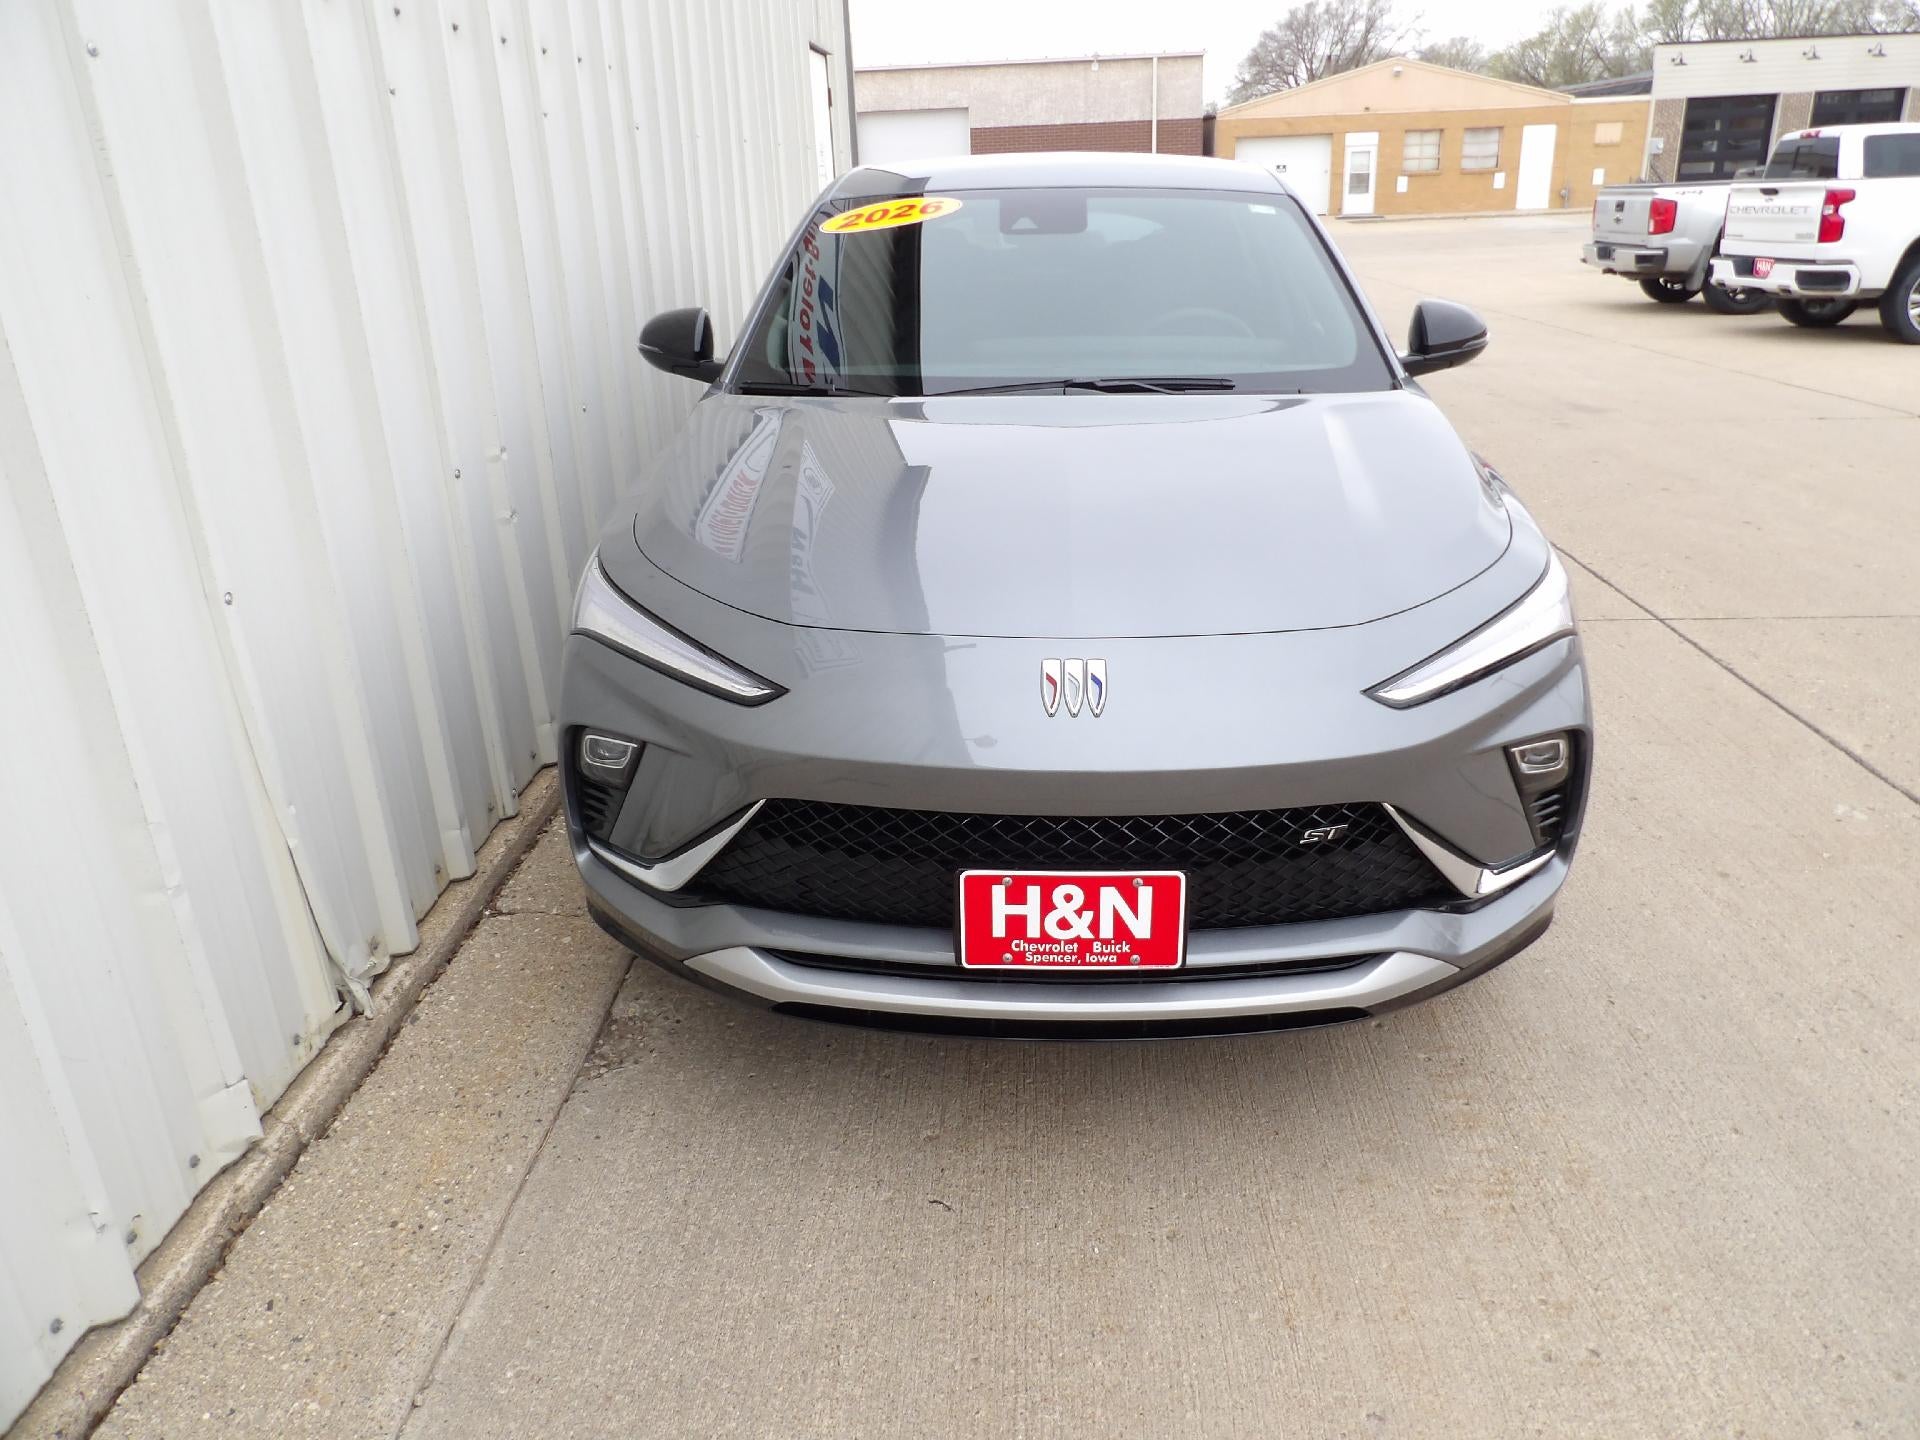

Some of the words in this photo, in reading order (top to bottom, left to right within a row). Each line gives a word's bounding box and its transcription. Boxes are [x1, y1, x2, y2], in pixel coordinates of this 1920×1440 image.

[835, 200, 945, 230] 2026
[1729, 205, 1809, 215] CHEVROLET
[1300, 824, 1348, 844] ST
[991, 883, 1153, 940] H&N
[1011, 939, 1079, 953] Chevrolet
[1093, 941, 1131, 953] Buick
[1025, 952, 1081, 964] Spencer,
[1086, 953, 1117, 963] Iowa
